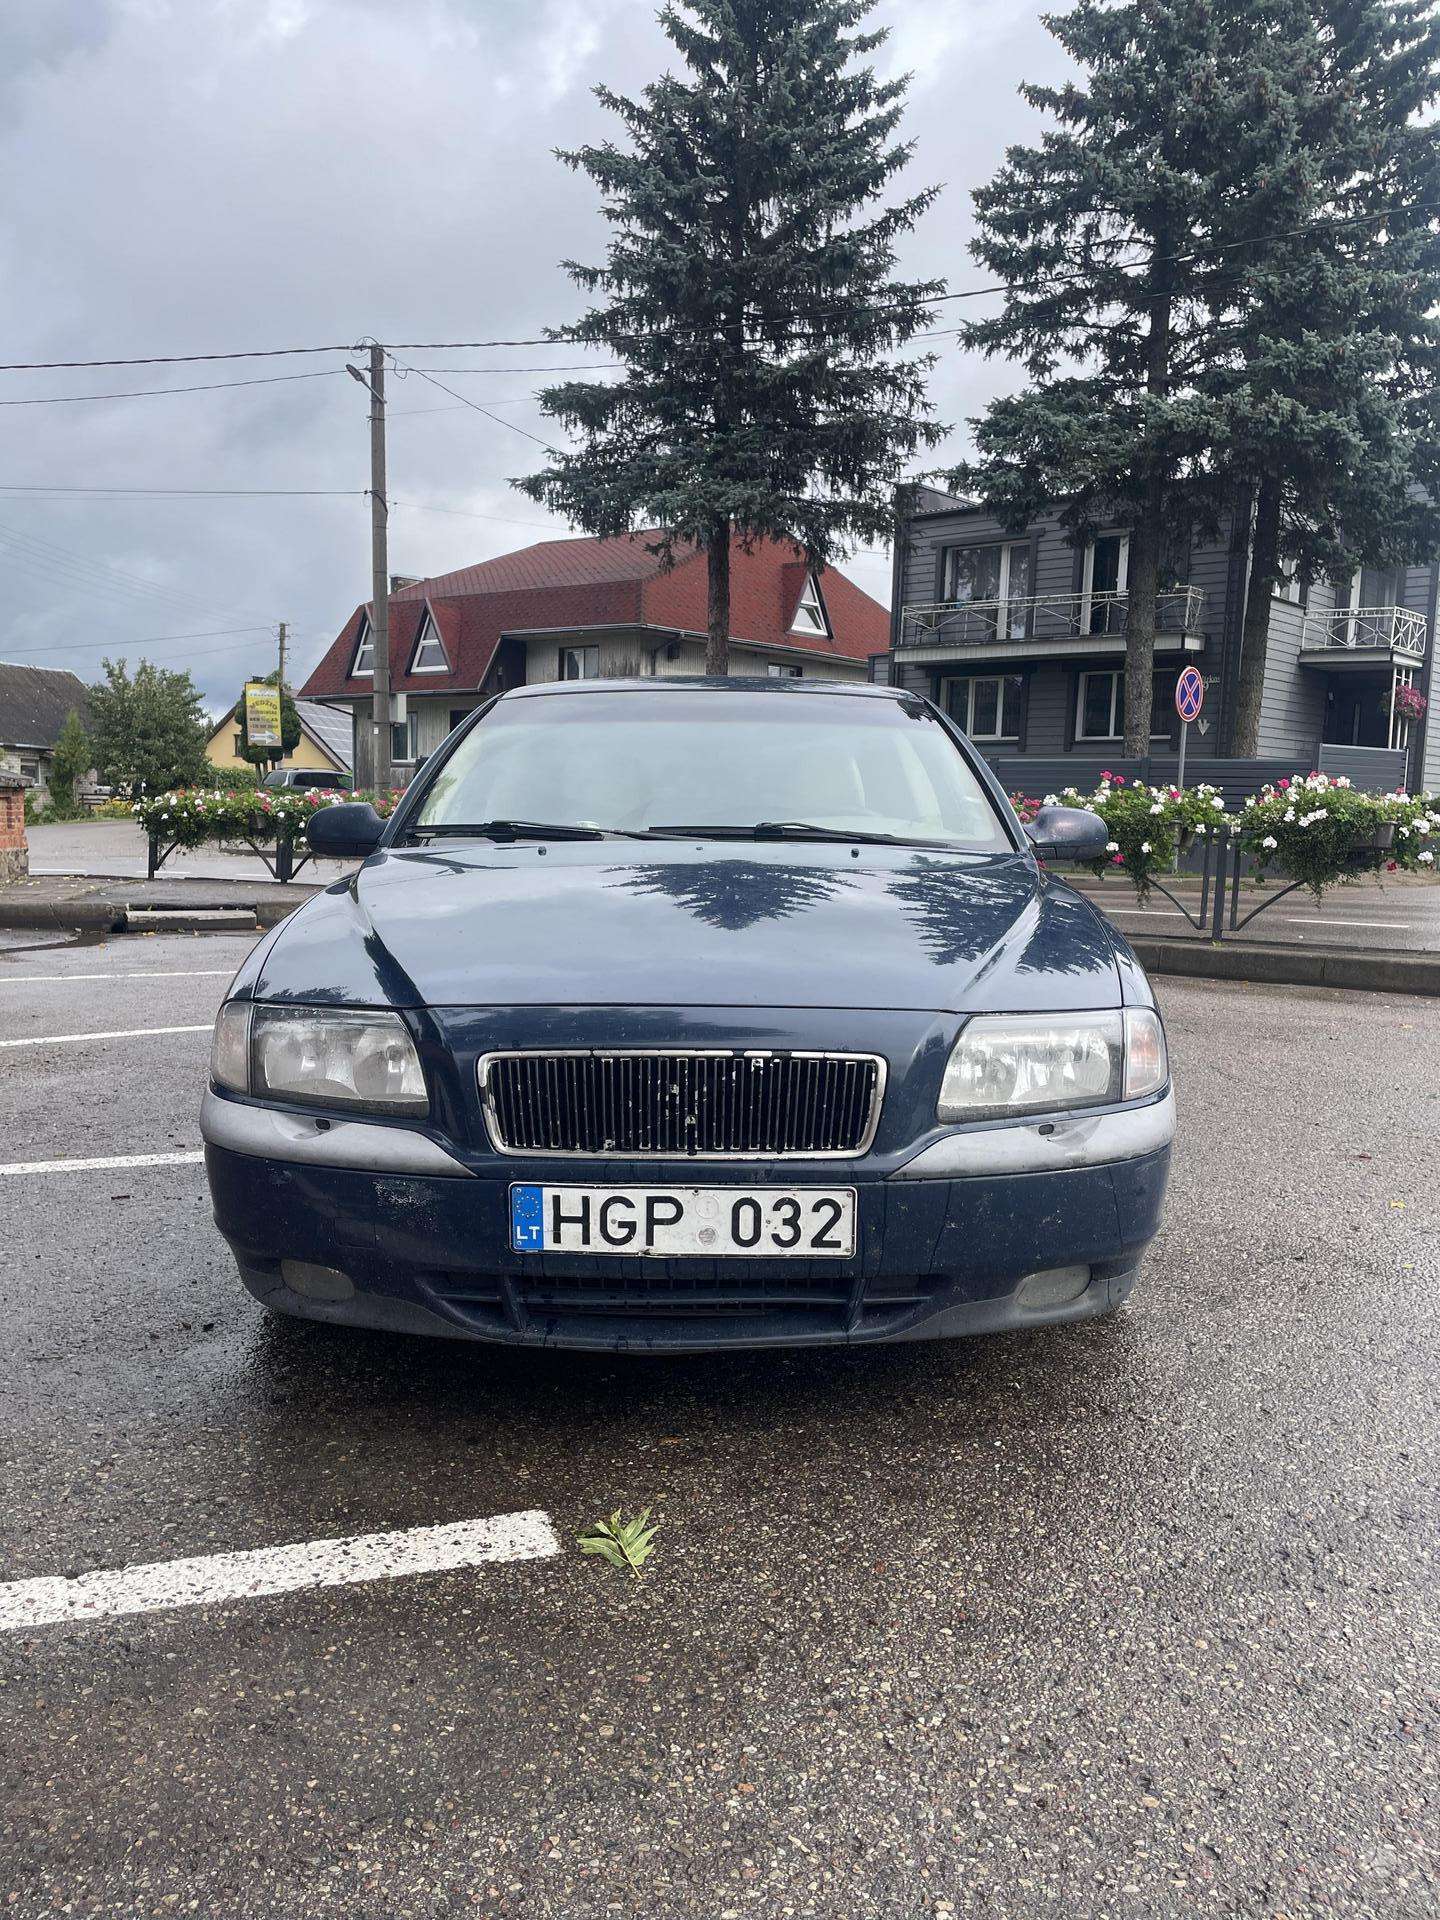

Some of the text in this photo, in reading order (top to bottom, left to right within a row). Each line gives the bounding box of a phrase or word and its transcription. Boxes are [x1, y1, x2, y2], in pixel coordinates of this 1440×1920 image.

[516, 1226, 540, 1240] LT
[552, 1195, 843, 1249] HGP 032
